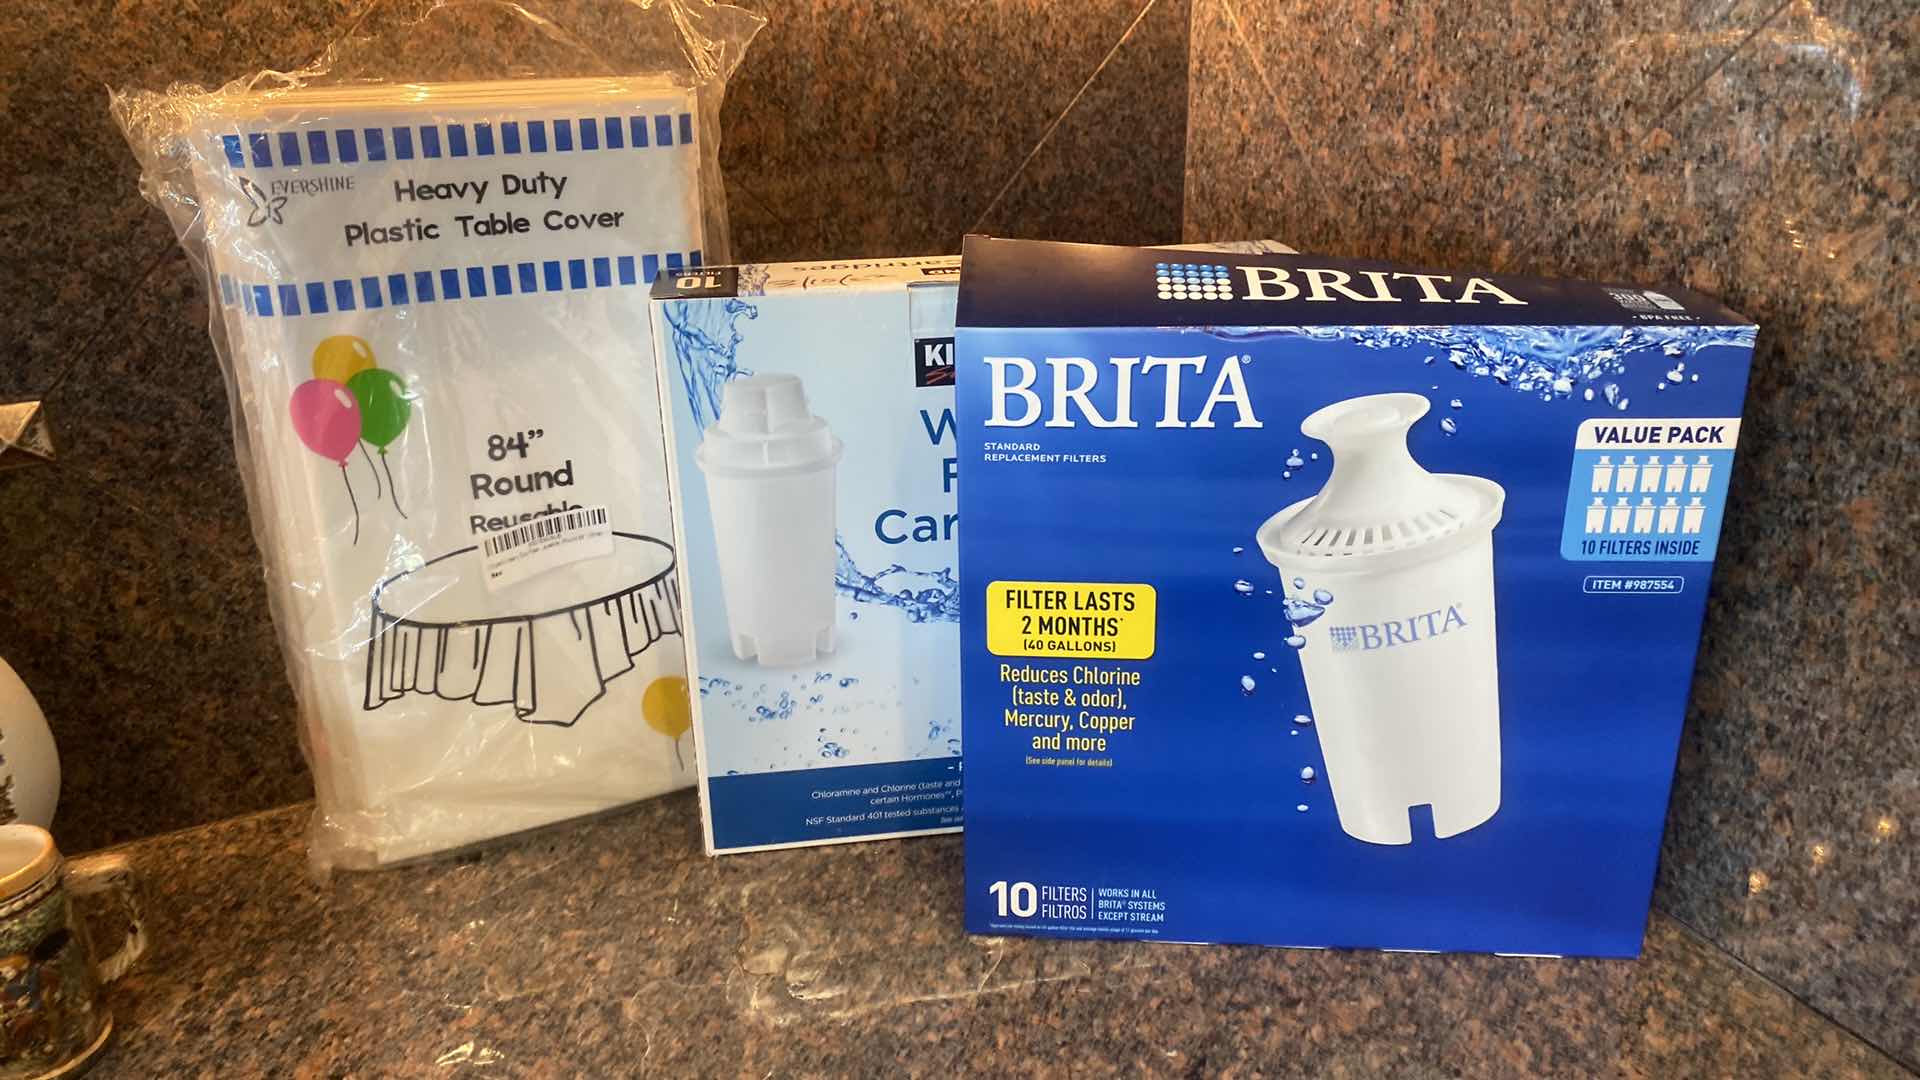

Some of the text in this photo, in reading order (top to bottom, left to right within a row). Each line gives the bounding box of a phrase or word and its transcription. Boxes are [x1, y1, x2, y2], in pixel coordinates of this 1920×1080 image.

[271, 176, 355, 196] EVERSHINE
[393, 171, 568, 204] Heavy Duty
[344, 208, 625, 247] Plastic Table Cover
[676, 276, 721, 289] 10
[1594, 426, 1725, 444] VALUE PACK
[984, 442, 1040, 451] STANDARD
[984, 453, 1107, 463] REPLACEMENT FILTERS
[470, 459, 574, 500] Round
[1581, 540, 1701, 555] 10 FILTERS INSIDE
[1592, 579, 1675, 590] ITEM #987554
[1006, 589, 1136, 612] FILTER LASTS
[1021, 616, 1032, 635] 2
[1023, 639, 1116, 652] (40 GALLONS)
[1000, 664, 1141, 686] Reduces Chlorine
[1012, 685, 1128, 710] (taste & odor),
[1004, 709, 1136, 733] Mercury, Copper
[1032, 732, 1106, 751] and more
[862, 786, 879, 795] and
[880, 783, 917, 794] Chlorine
[944, 779, 961, 788] and
[870, 795, 900, 805] certain
[806, 806, 960, 827] NSF Standard 401 tested substances
[989, 880, 1037, 918] 10
[1042, 885, 1087, 902] FILTERS
[1098, 888, 1157, 899] WORKS IN ALL
[1042, 904, 1087, 920] FILTROS
[1128, 901, 1166, 911] SYSTEMS
[1098, 911, 1164, 922] EXCEPT STREAM
